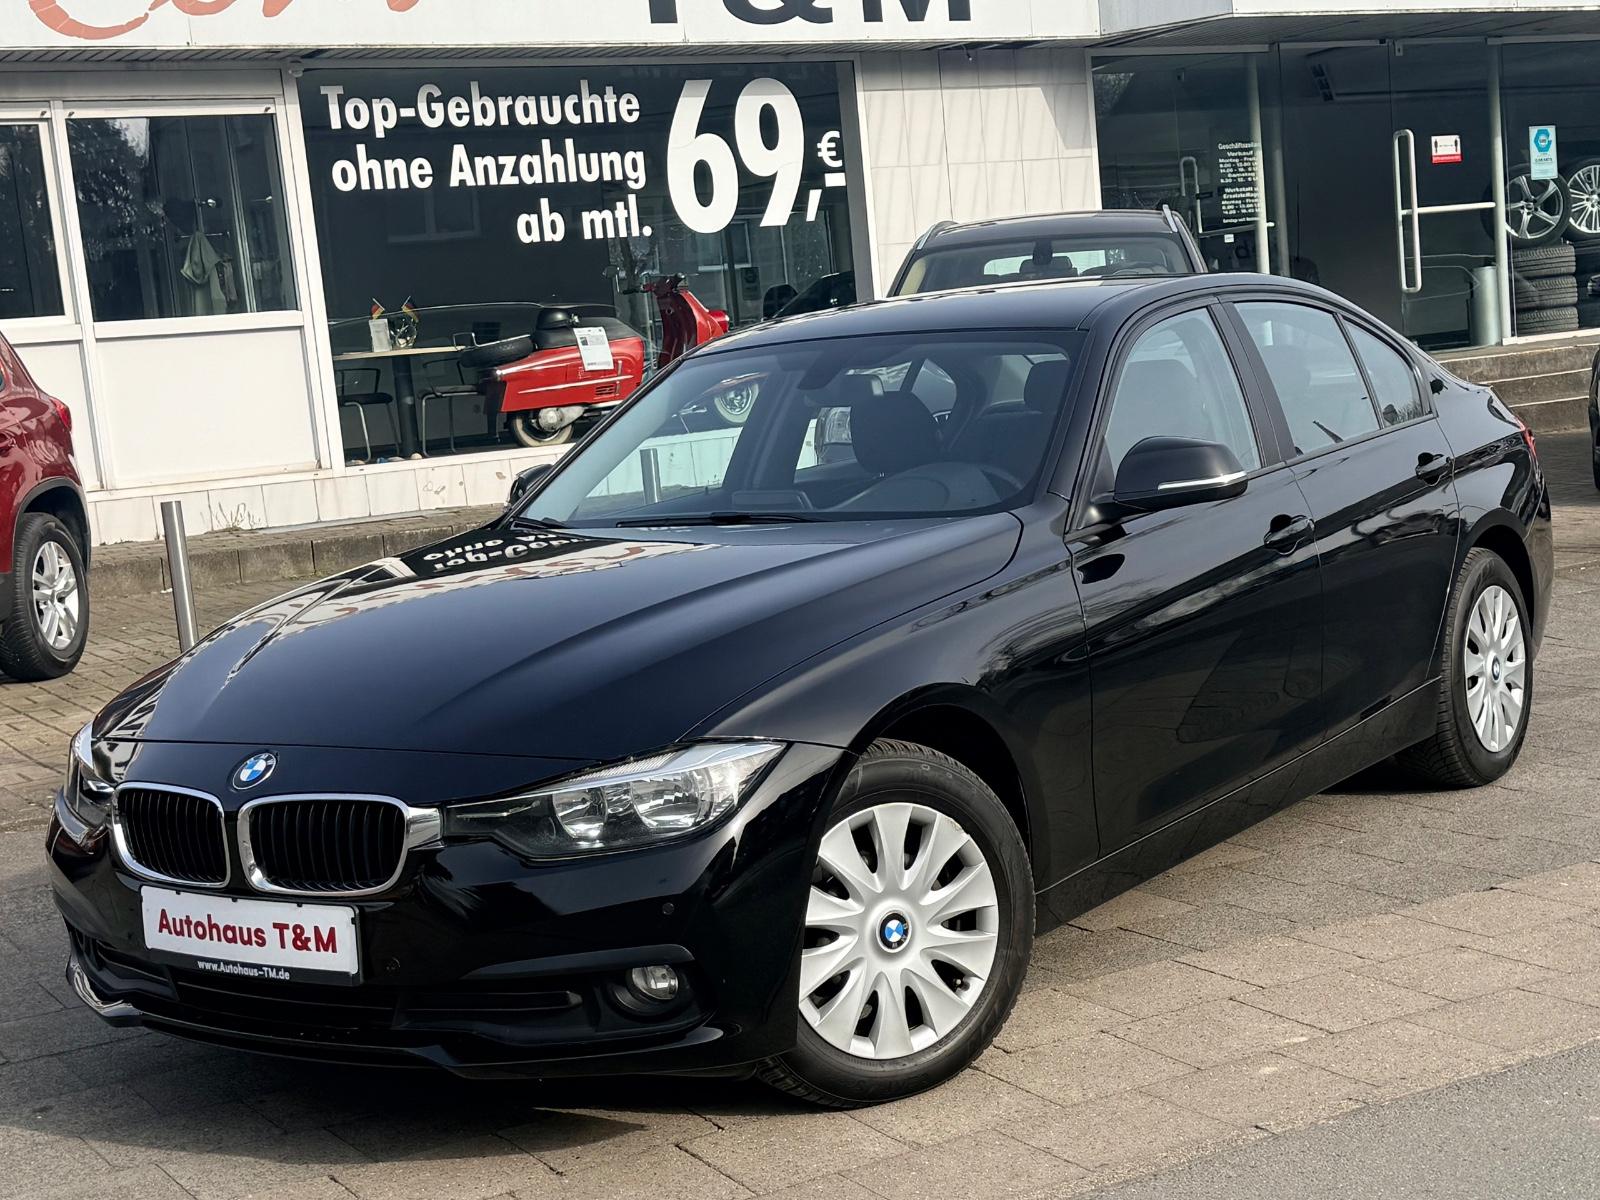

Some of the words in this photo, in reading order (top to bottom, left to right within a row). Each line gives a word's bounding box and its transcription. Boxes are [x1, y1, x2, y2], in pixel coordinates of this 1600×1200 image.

[320, 79, 641, 139] Top-Gebrauchte
[331, 153, 434, 192] ohne
[448, 138, 648, 192] Anzahlung
[515, 197, 566, 244] ab
[580, 193, 654, 241] mtl.
[158, 908, 267, 948] Autohaus
[272, 922, 338, 954] T&M
[197, 961, 290, 980] www.Autohaus-TM.de
